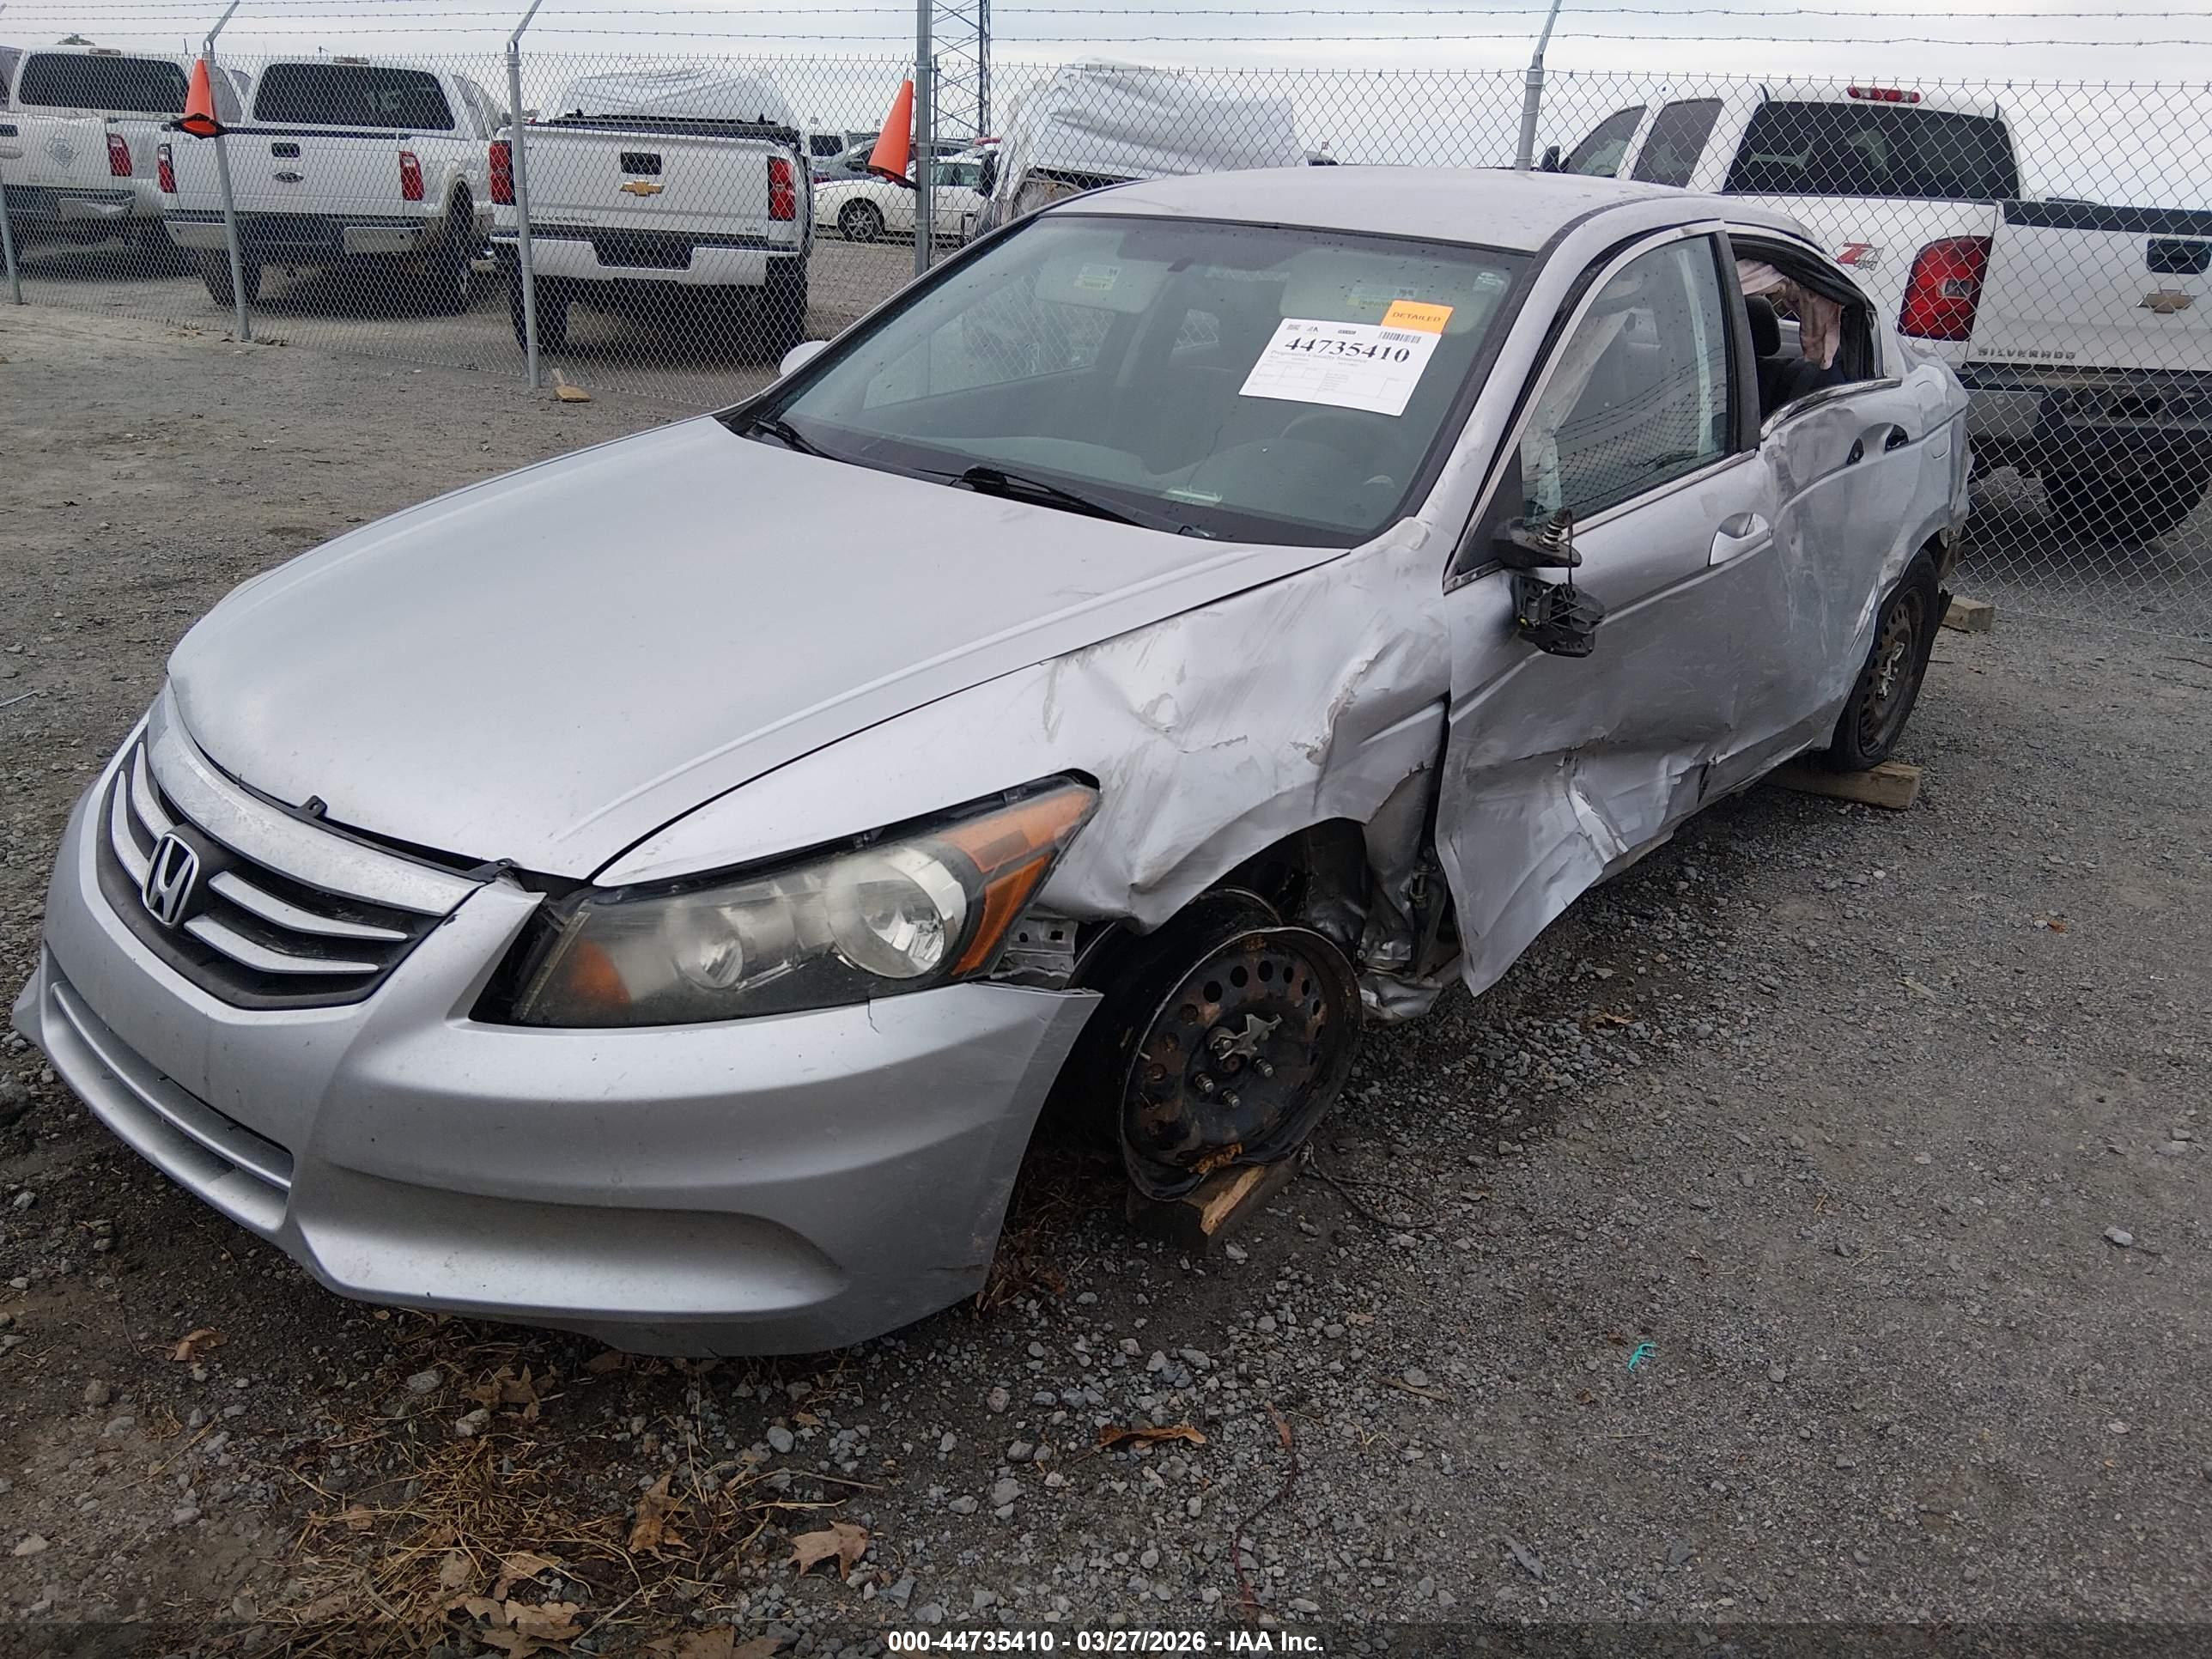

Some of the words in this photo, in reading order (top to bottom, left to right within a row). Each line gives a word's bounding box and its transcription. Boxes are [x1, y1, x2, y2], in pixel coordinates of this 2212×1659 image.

[1393, 312, 1442, 322] DETAILED
[1285, 337, 1410, 362] 44735410
[1978, 348, 2076, 359] SILVERADO
